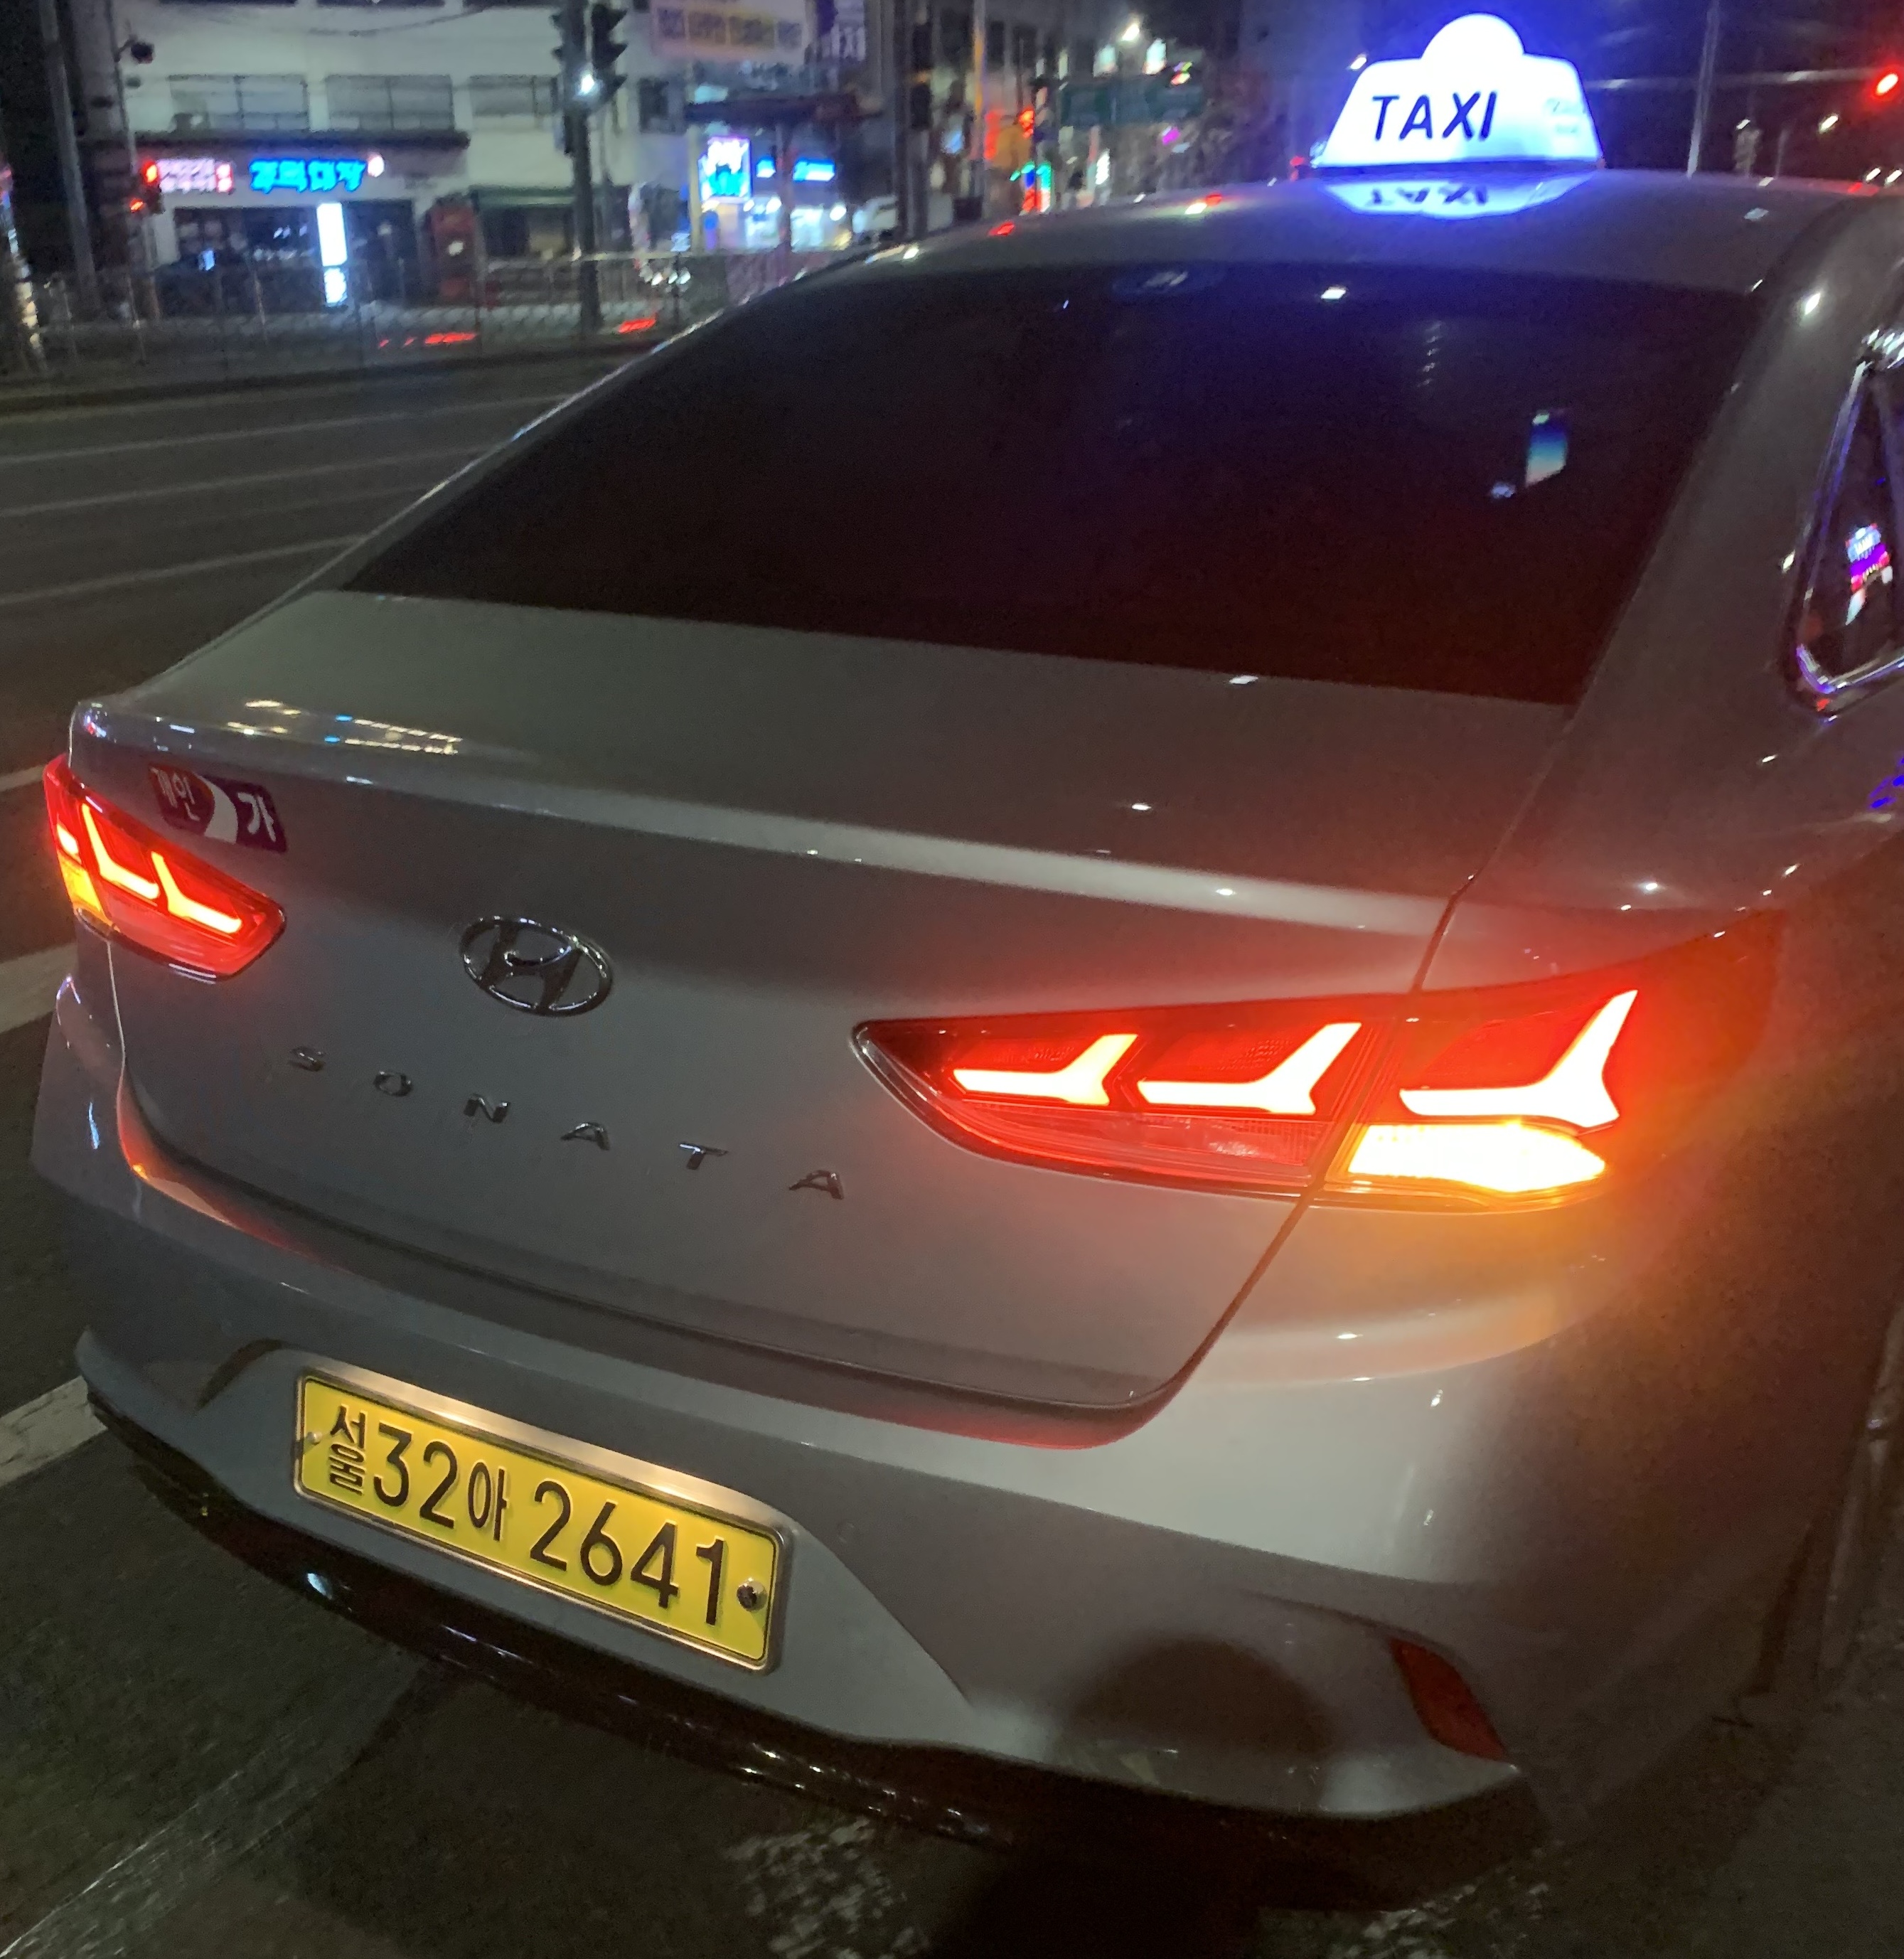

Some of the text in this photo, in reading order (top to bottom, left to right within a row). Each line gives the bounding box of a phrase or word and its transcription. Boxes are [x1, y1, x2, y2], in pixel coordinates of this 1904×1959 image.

[1371, 90, 1497, 142] TAXI
[288, 1045, 845, 1202] SONATA
[328, 1404, 726, 1627] 서울 32아 2641
